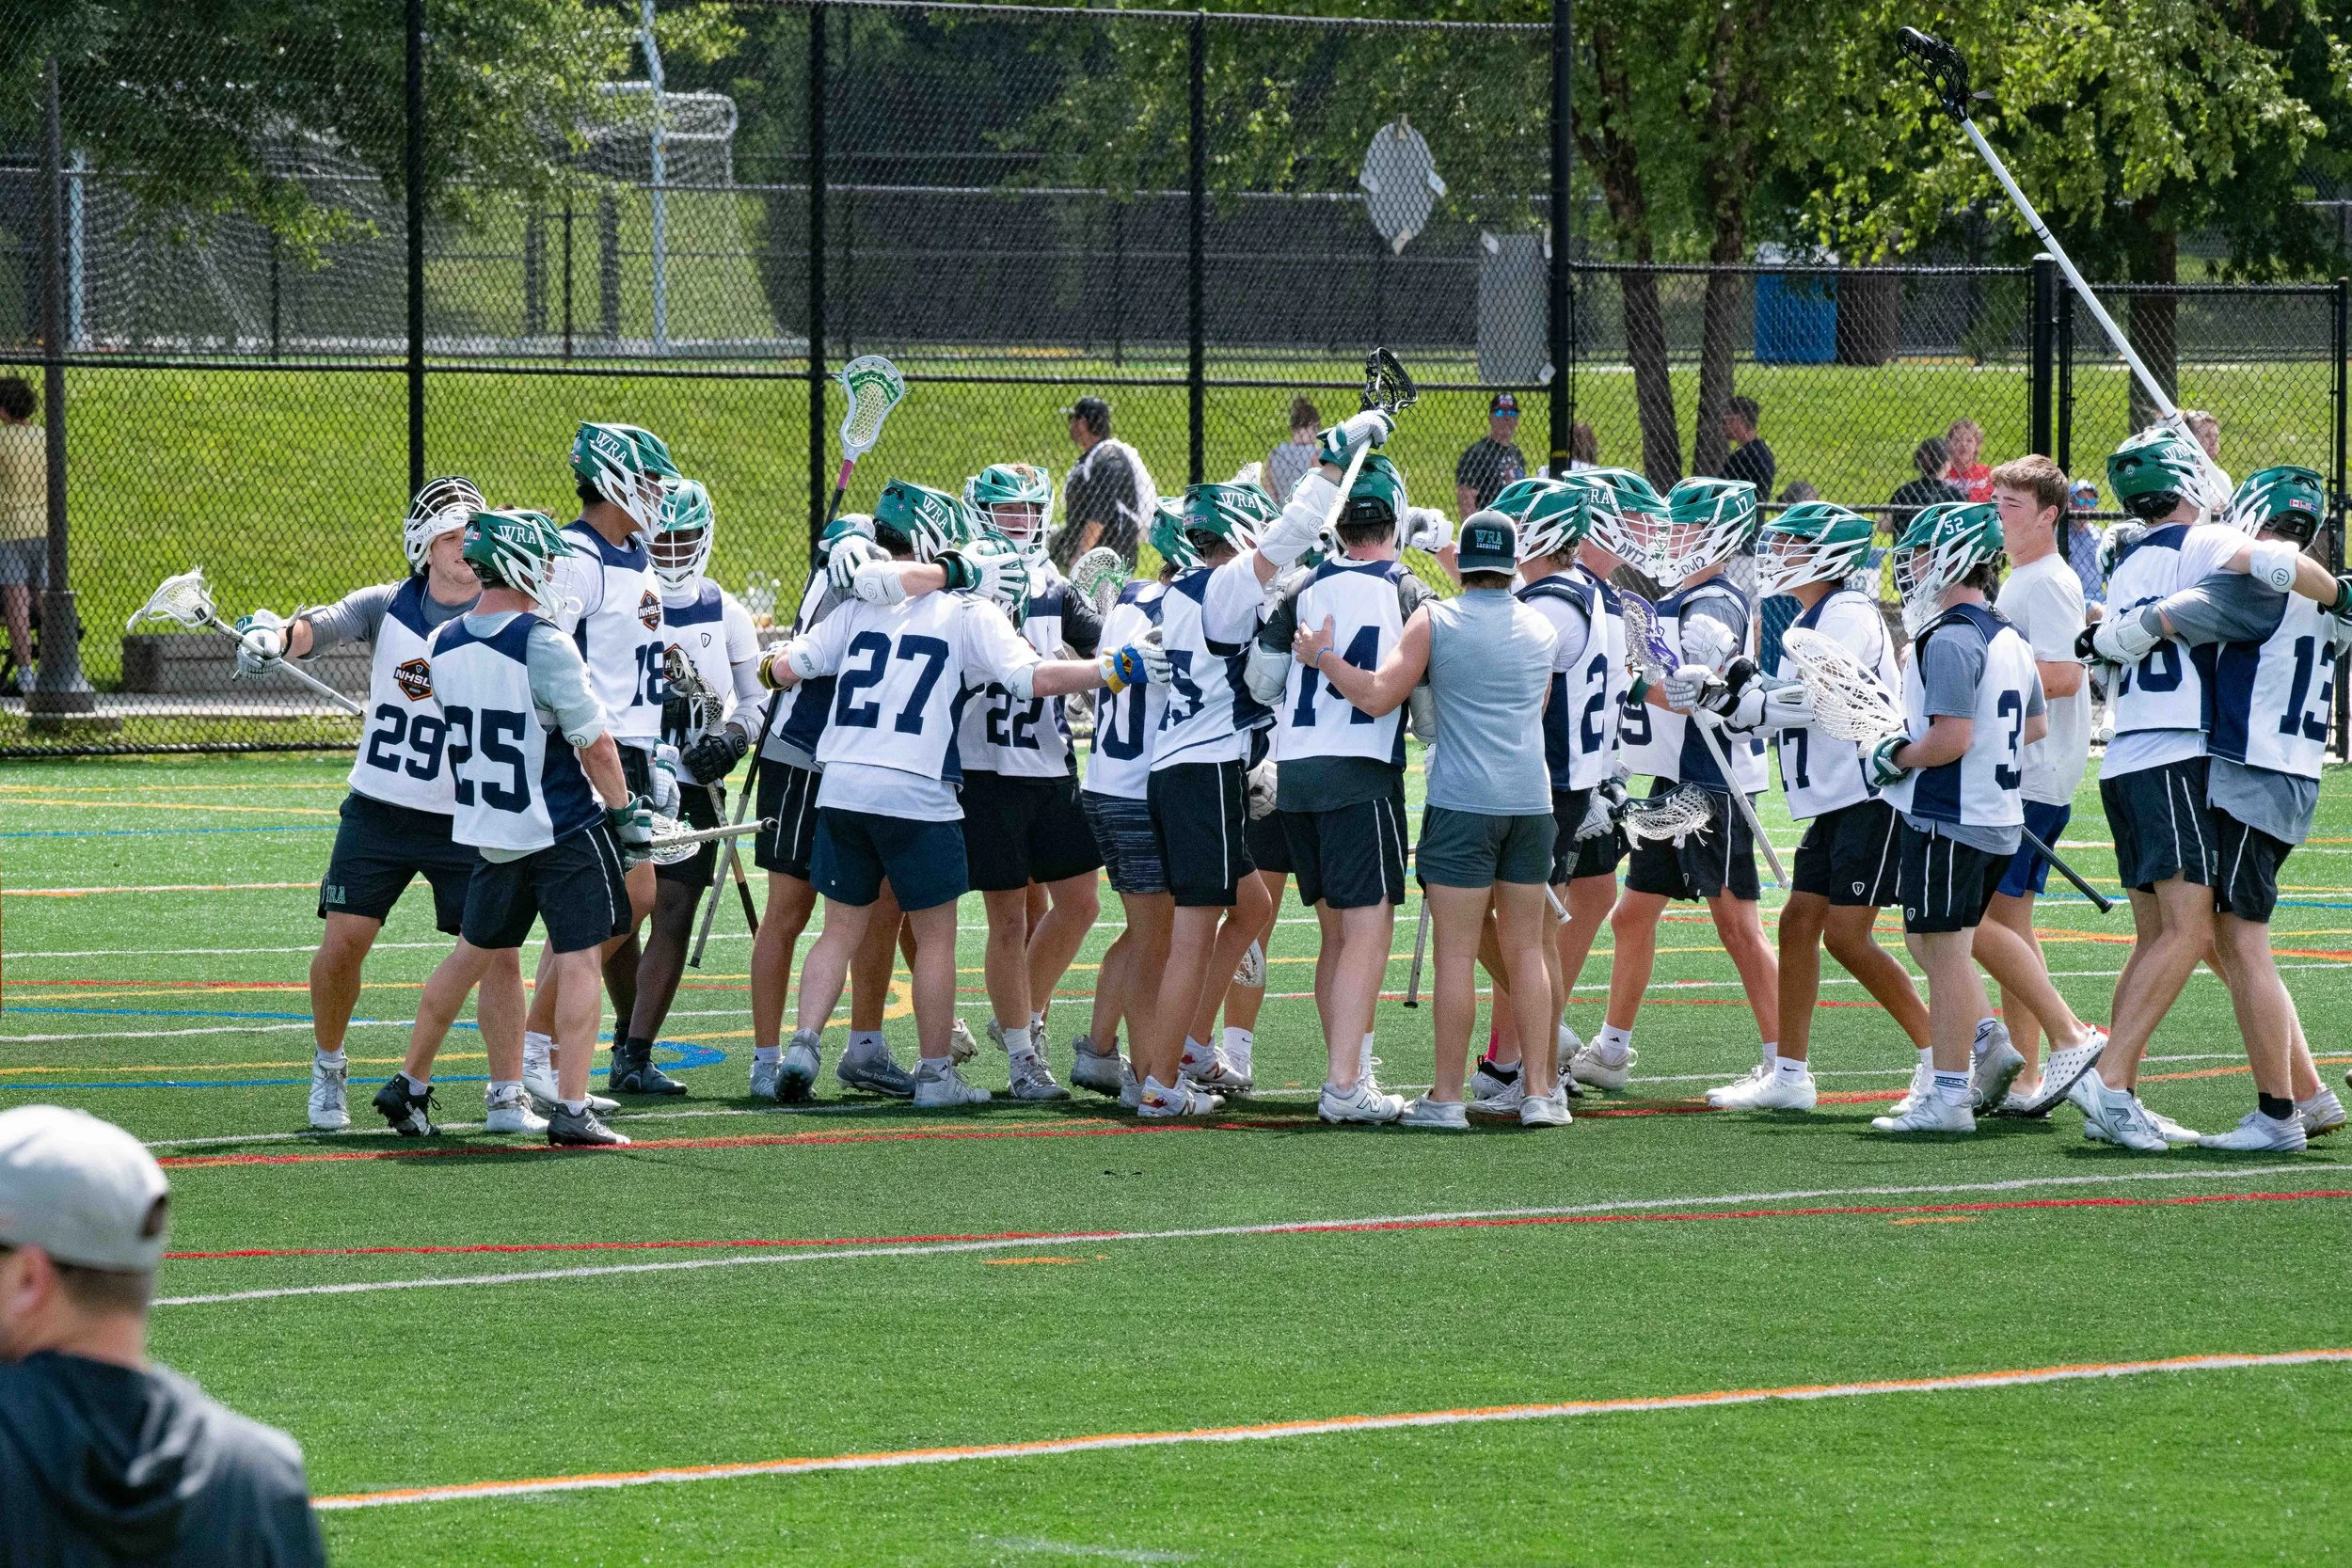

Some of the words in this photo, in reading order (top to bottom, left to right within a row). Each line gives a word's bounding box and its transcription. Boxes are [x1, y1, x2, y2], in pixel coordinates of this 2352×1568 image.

[595, 430, 628, 465] WRA
[921, 495, 949, 531] WRA
[1219, 492, 1257, 509] WRA
[1588, 487, 1611, 505] RA
[1735, 496, 1749, 515] 17
[499, 525, 537, 545] WRA
[1475, 530, 1503, 546] WRA
[1944, 517, 1965, 535] 52
[630, 641, 664, 706] 18
[835, 631, 949, 736] 27
[1292, 626, 1380, 727] 14
[2279, 636, 2336, 743] 13
[986, 682, 1045, 750] 22
[366, 703, 447, 782] 29
[444, 705, 532, 815] 25
[326, 884, 346, 905] RA
[856, 1068, 873, 1077] new
[873, 1072, 905, 1085] balance
